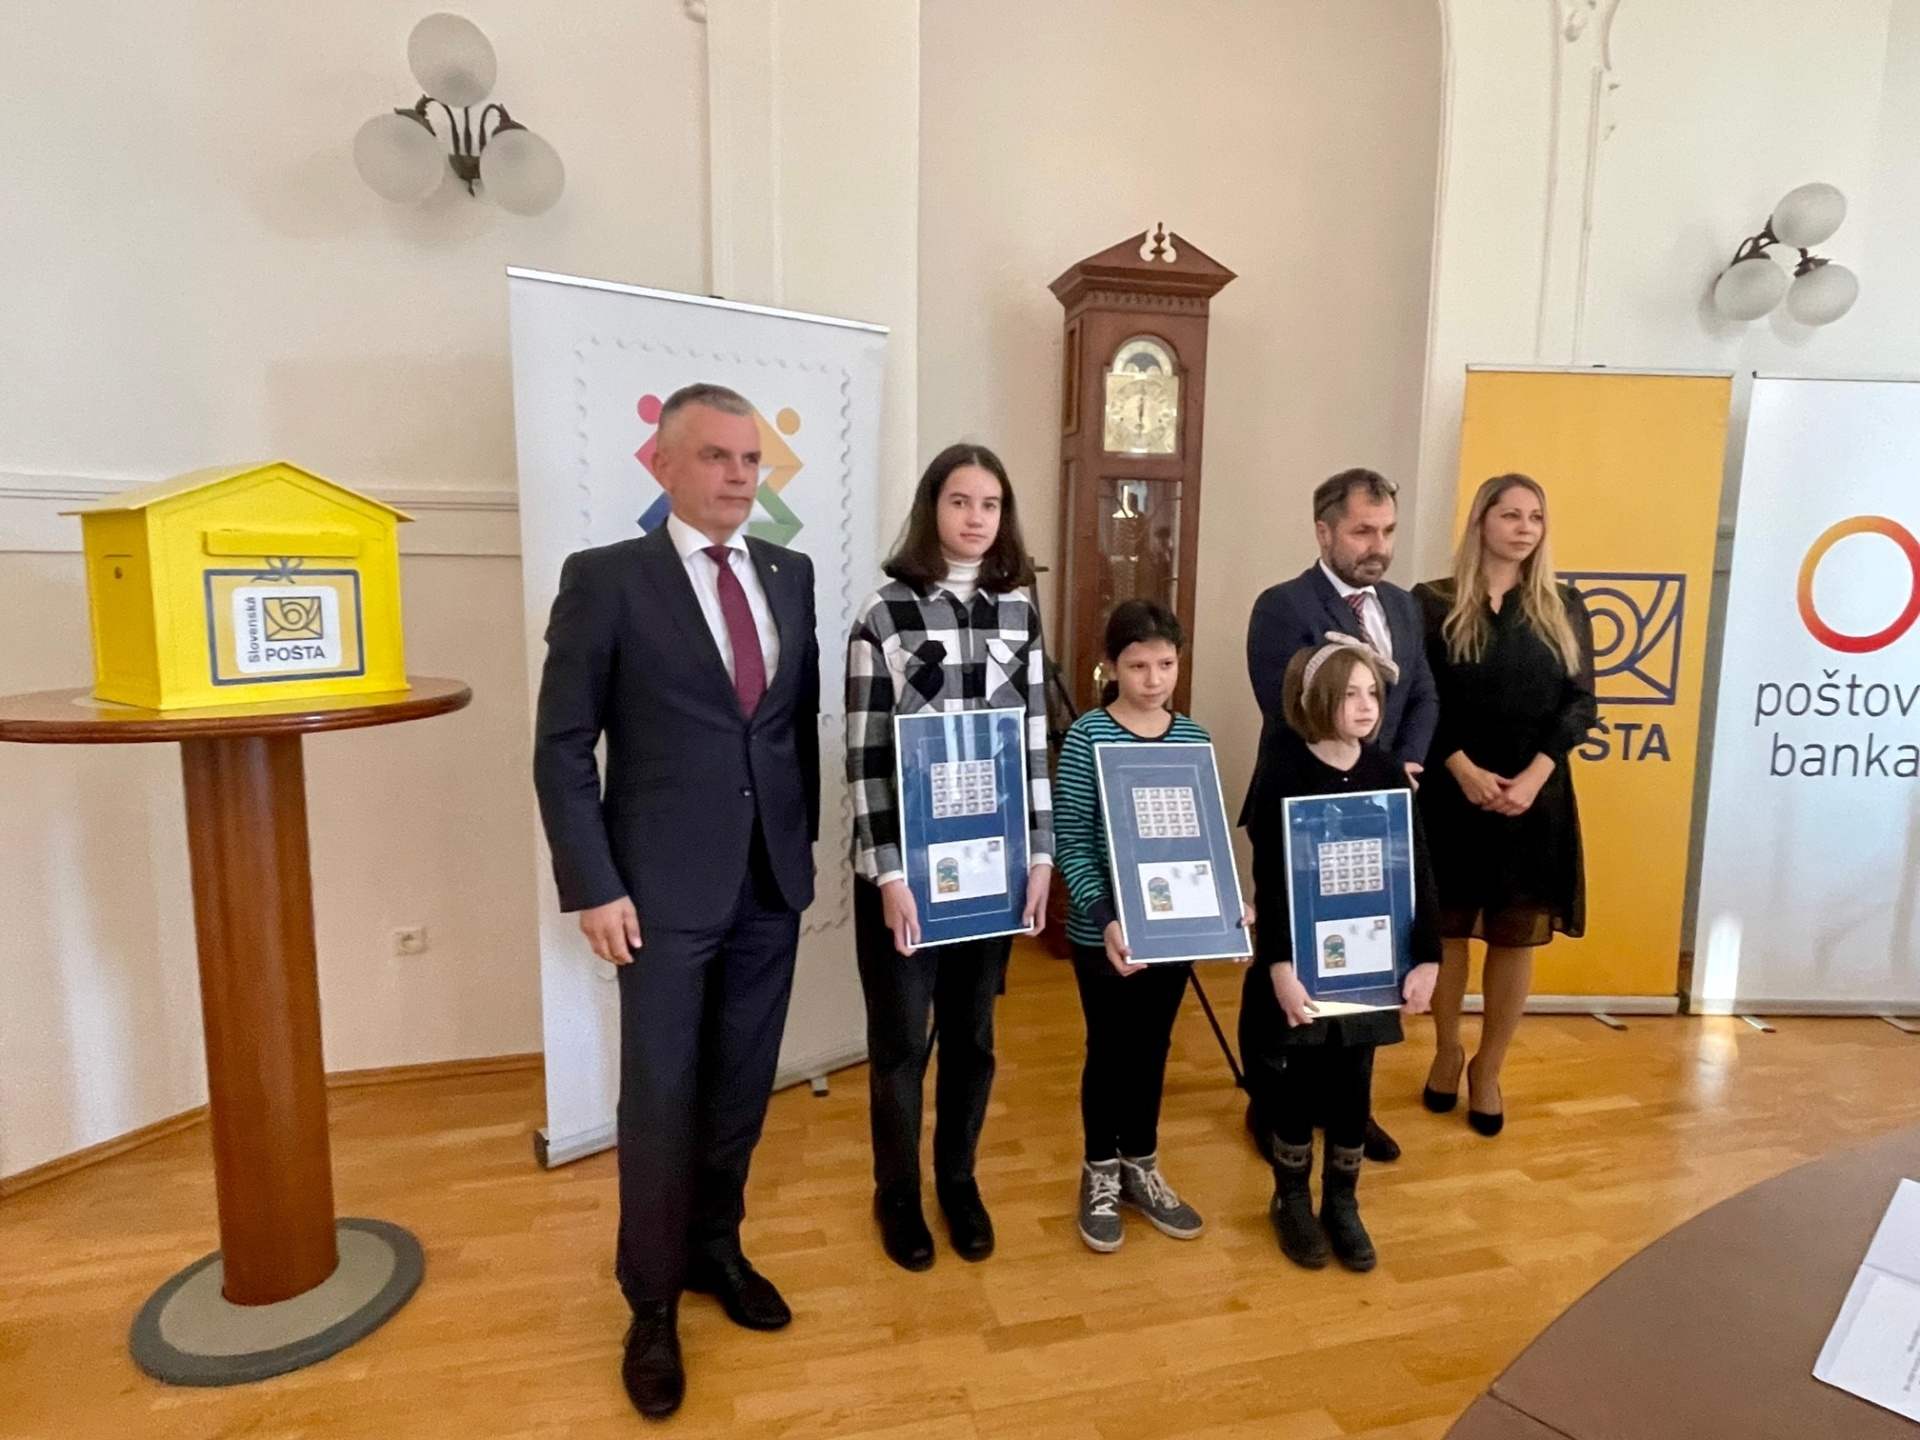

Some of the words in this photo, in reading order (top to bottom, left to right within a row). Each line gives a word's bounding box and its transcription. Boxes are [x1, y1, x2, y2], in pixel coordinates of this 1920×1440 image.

[244, 597, 261, 663] Slovenská
[265, 645, 325, 661] POŠTA
[1755, 668, 1920, 727] poštov
[1578, 716, 1671, 762] ŠTA
[1770, 731, 1920, 777] banka
